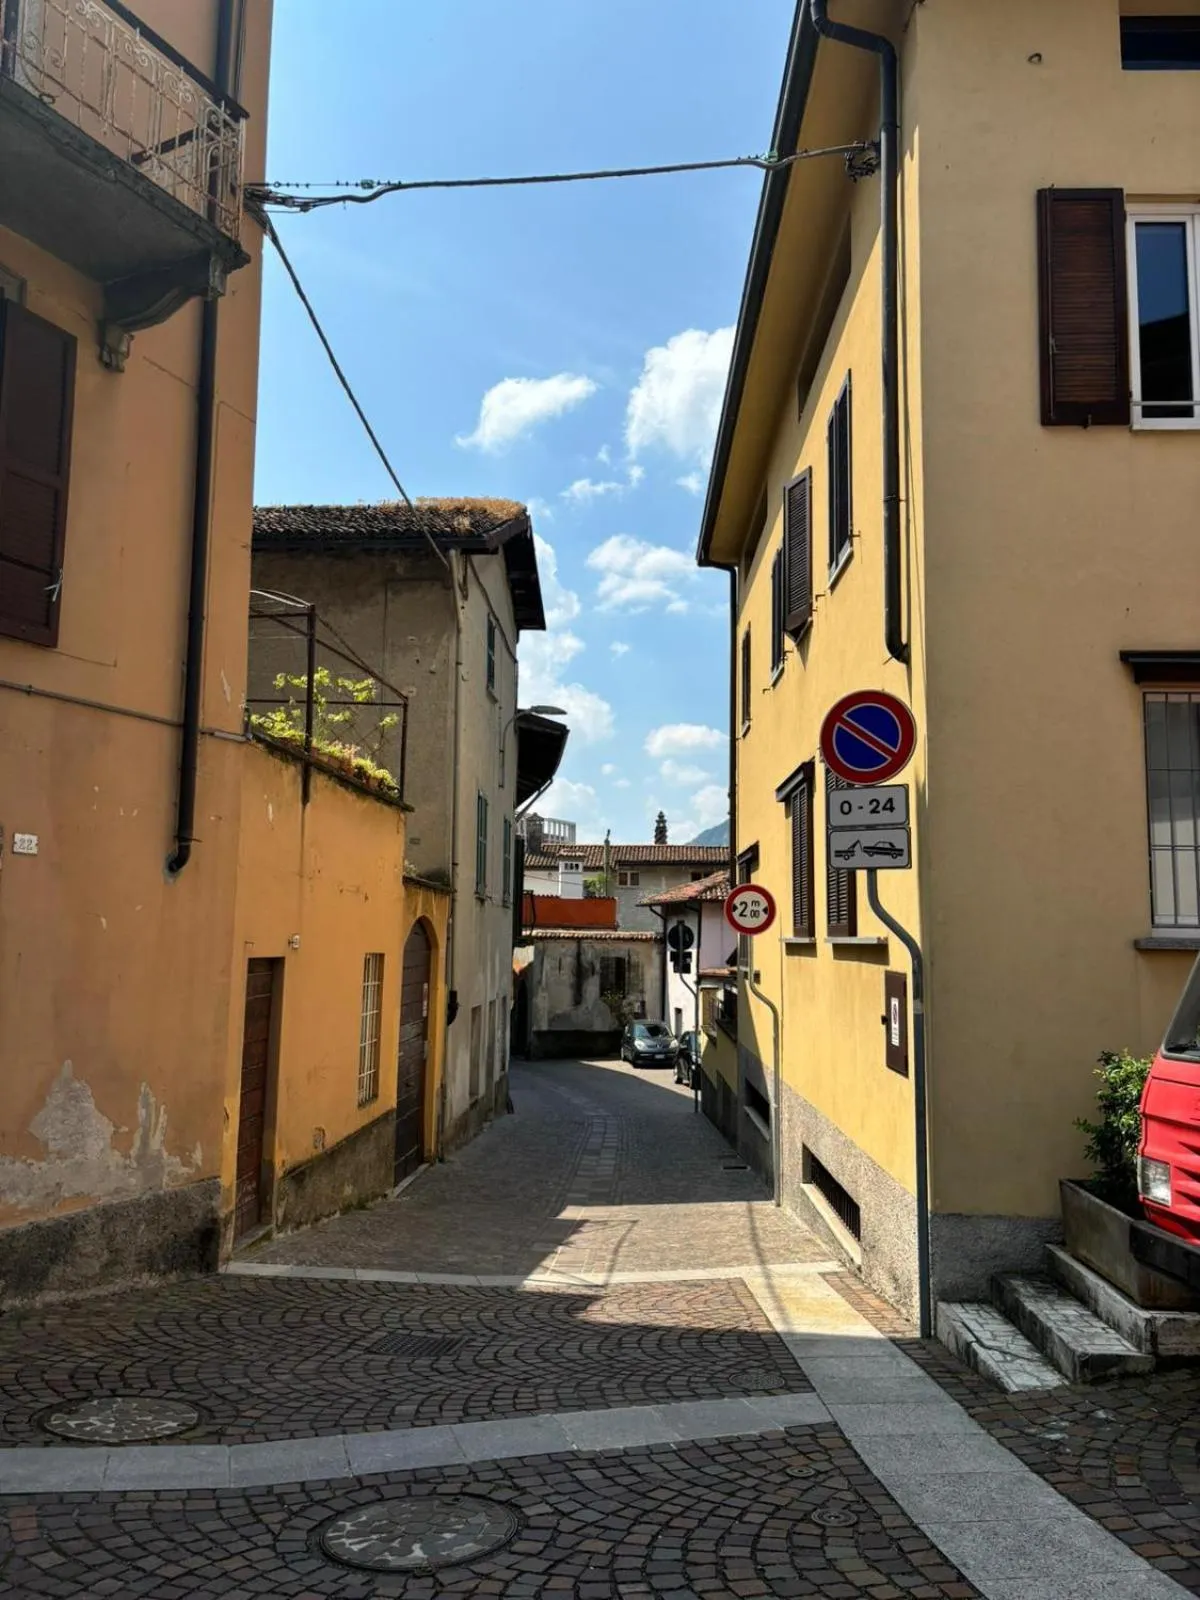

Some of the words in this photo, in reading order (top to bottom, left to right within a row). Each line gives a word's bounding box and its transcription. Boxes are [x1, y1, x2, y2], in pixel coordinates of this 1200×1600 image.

[840, 800, 852, 815] 0
[869, 797, 896, 814] 24
[19, 838, 33, 851] 22
[739, 901, 748, 917] 2
